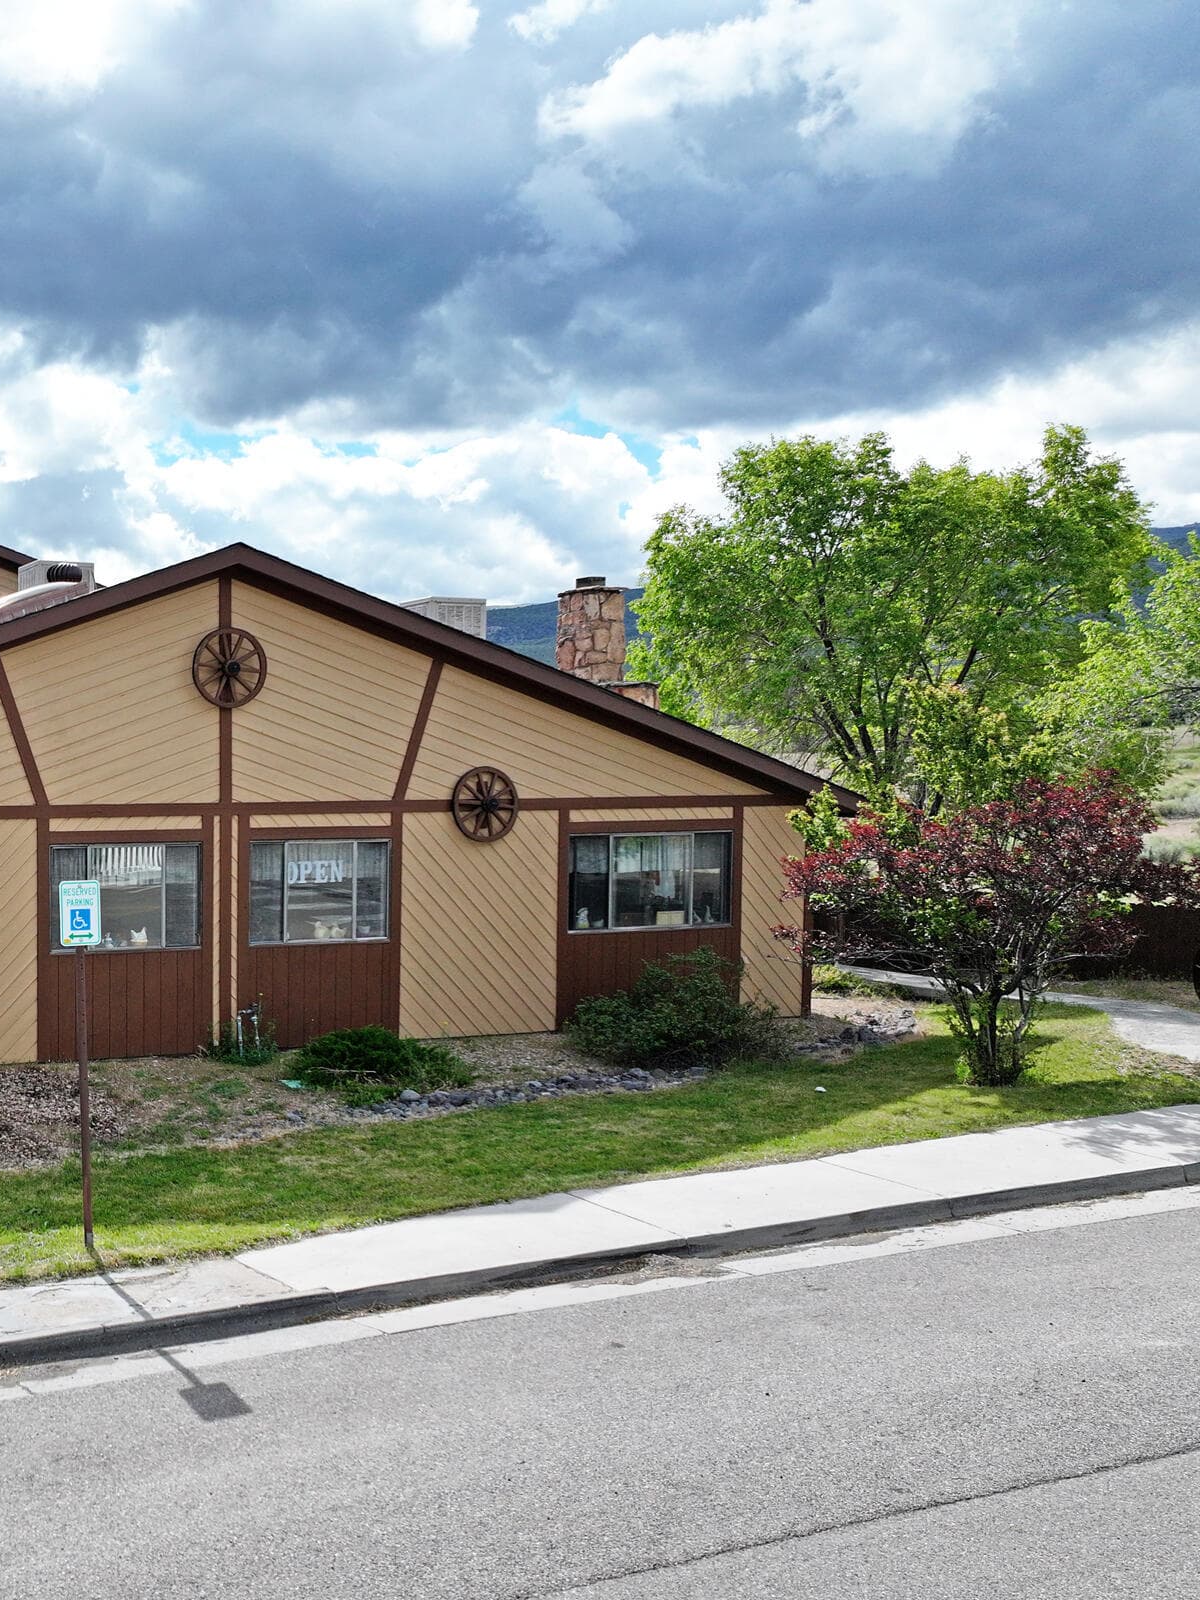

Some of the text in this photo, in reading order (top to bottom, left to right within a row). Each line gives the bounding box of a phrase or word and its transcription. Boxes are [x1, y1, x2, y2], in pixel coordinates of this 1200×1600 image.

[287, 860, 344, 884] OPEN
[63, 887, 97, 896] RESERVED
[66, 898, 94, 906] PARKING
